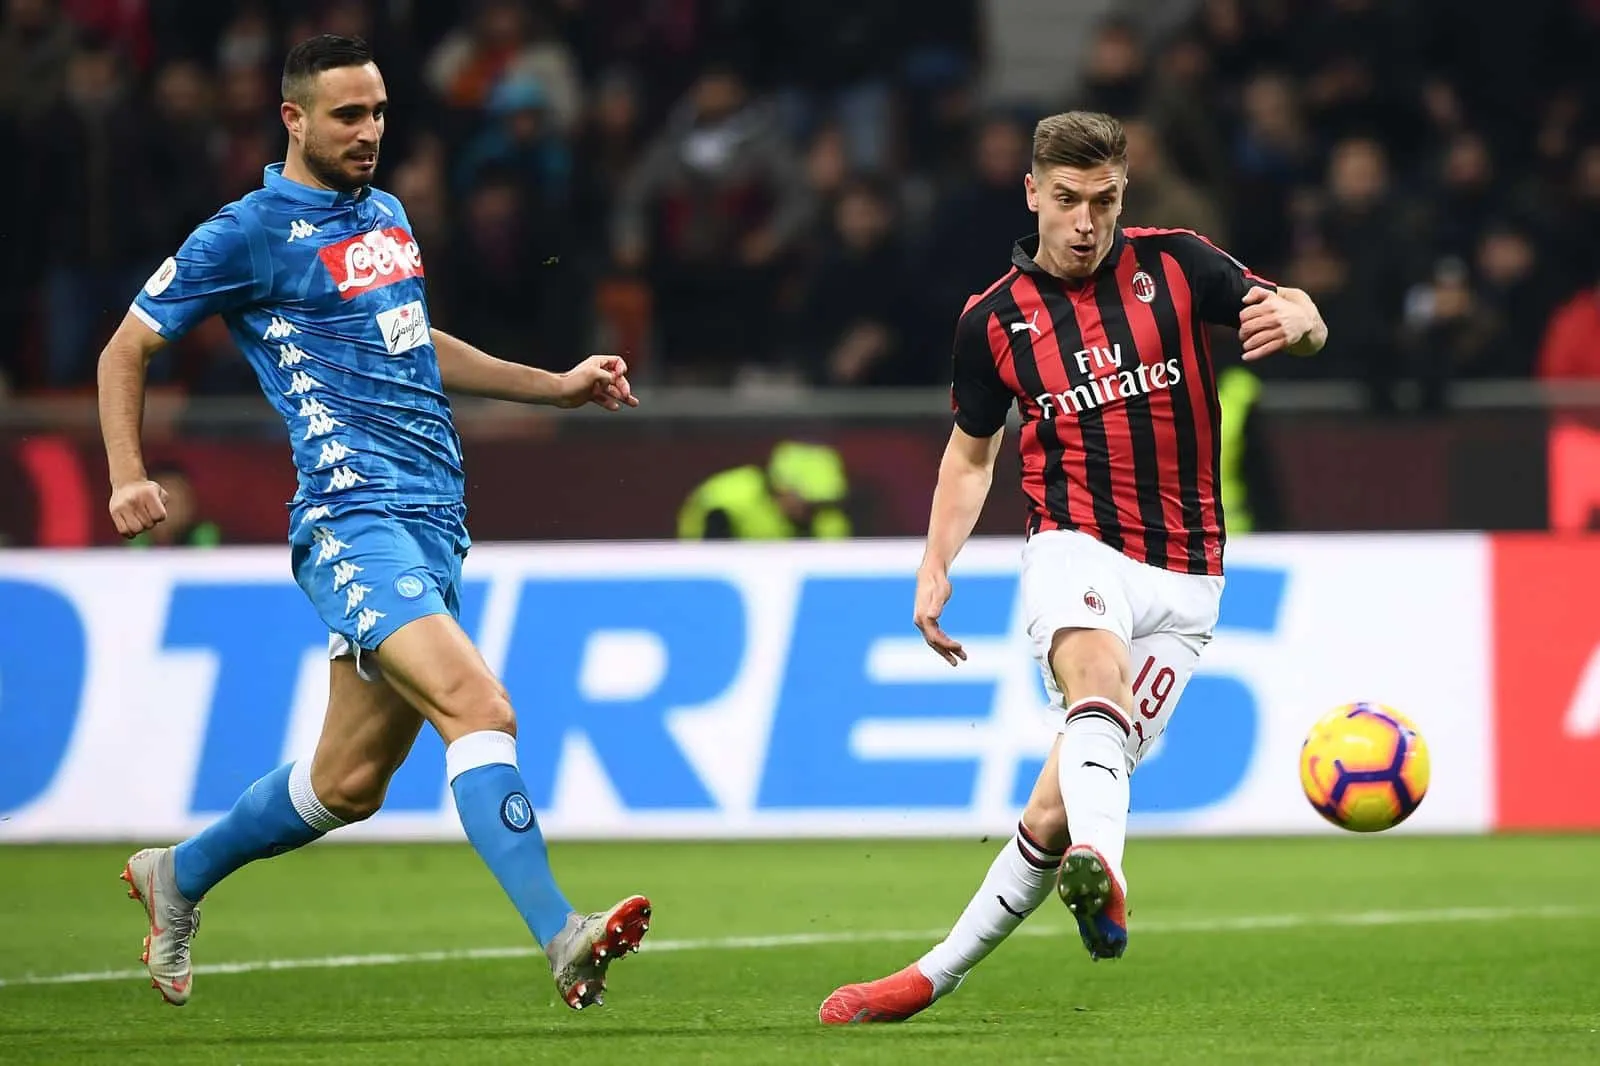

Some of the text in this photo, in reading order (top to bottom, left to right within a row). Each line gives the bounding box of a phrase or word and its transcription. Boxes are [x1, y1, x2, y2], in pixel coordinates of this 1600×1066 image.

[1074, 344, 1122, 374] Fly
[1036, 358, 1181, 420] Emirates
[1132, 656, 1176, 719] 19
[509, 800, 524, 821] N
